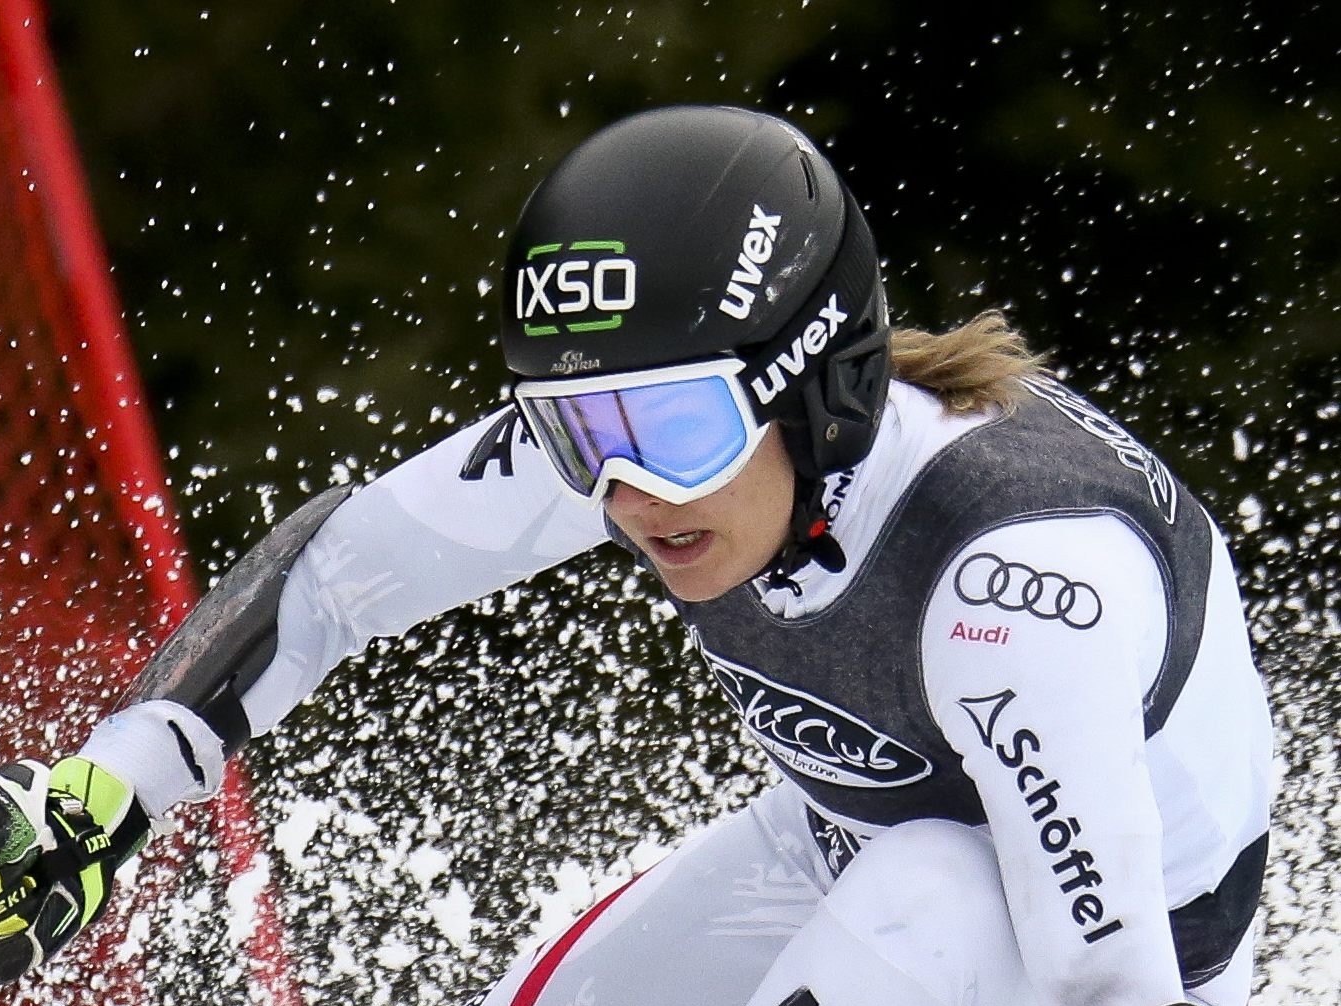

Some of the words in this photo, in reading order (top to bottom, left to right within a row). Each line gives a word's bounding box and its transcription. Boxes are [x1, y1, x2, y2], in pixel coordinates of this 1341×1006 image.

[719, 204, 782, 320] uvex
[750, 293, 849, 405] uvex
[949, 621, 1011, 646] Audi
[996, 728, 1124, 944] Schöffel
